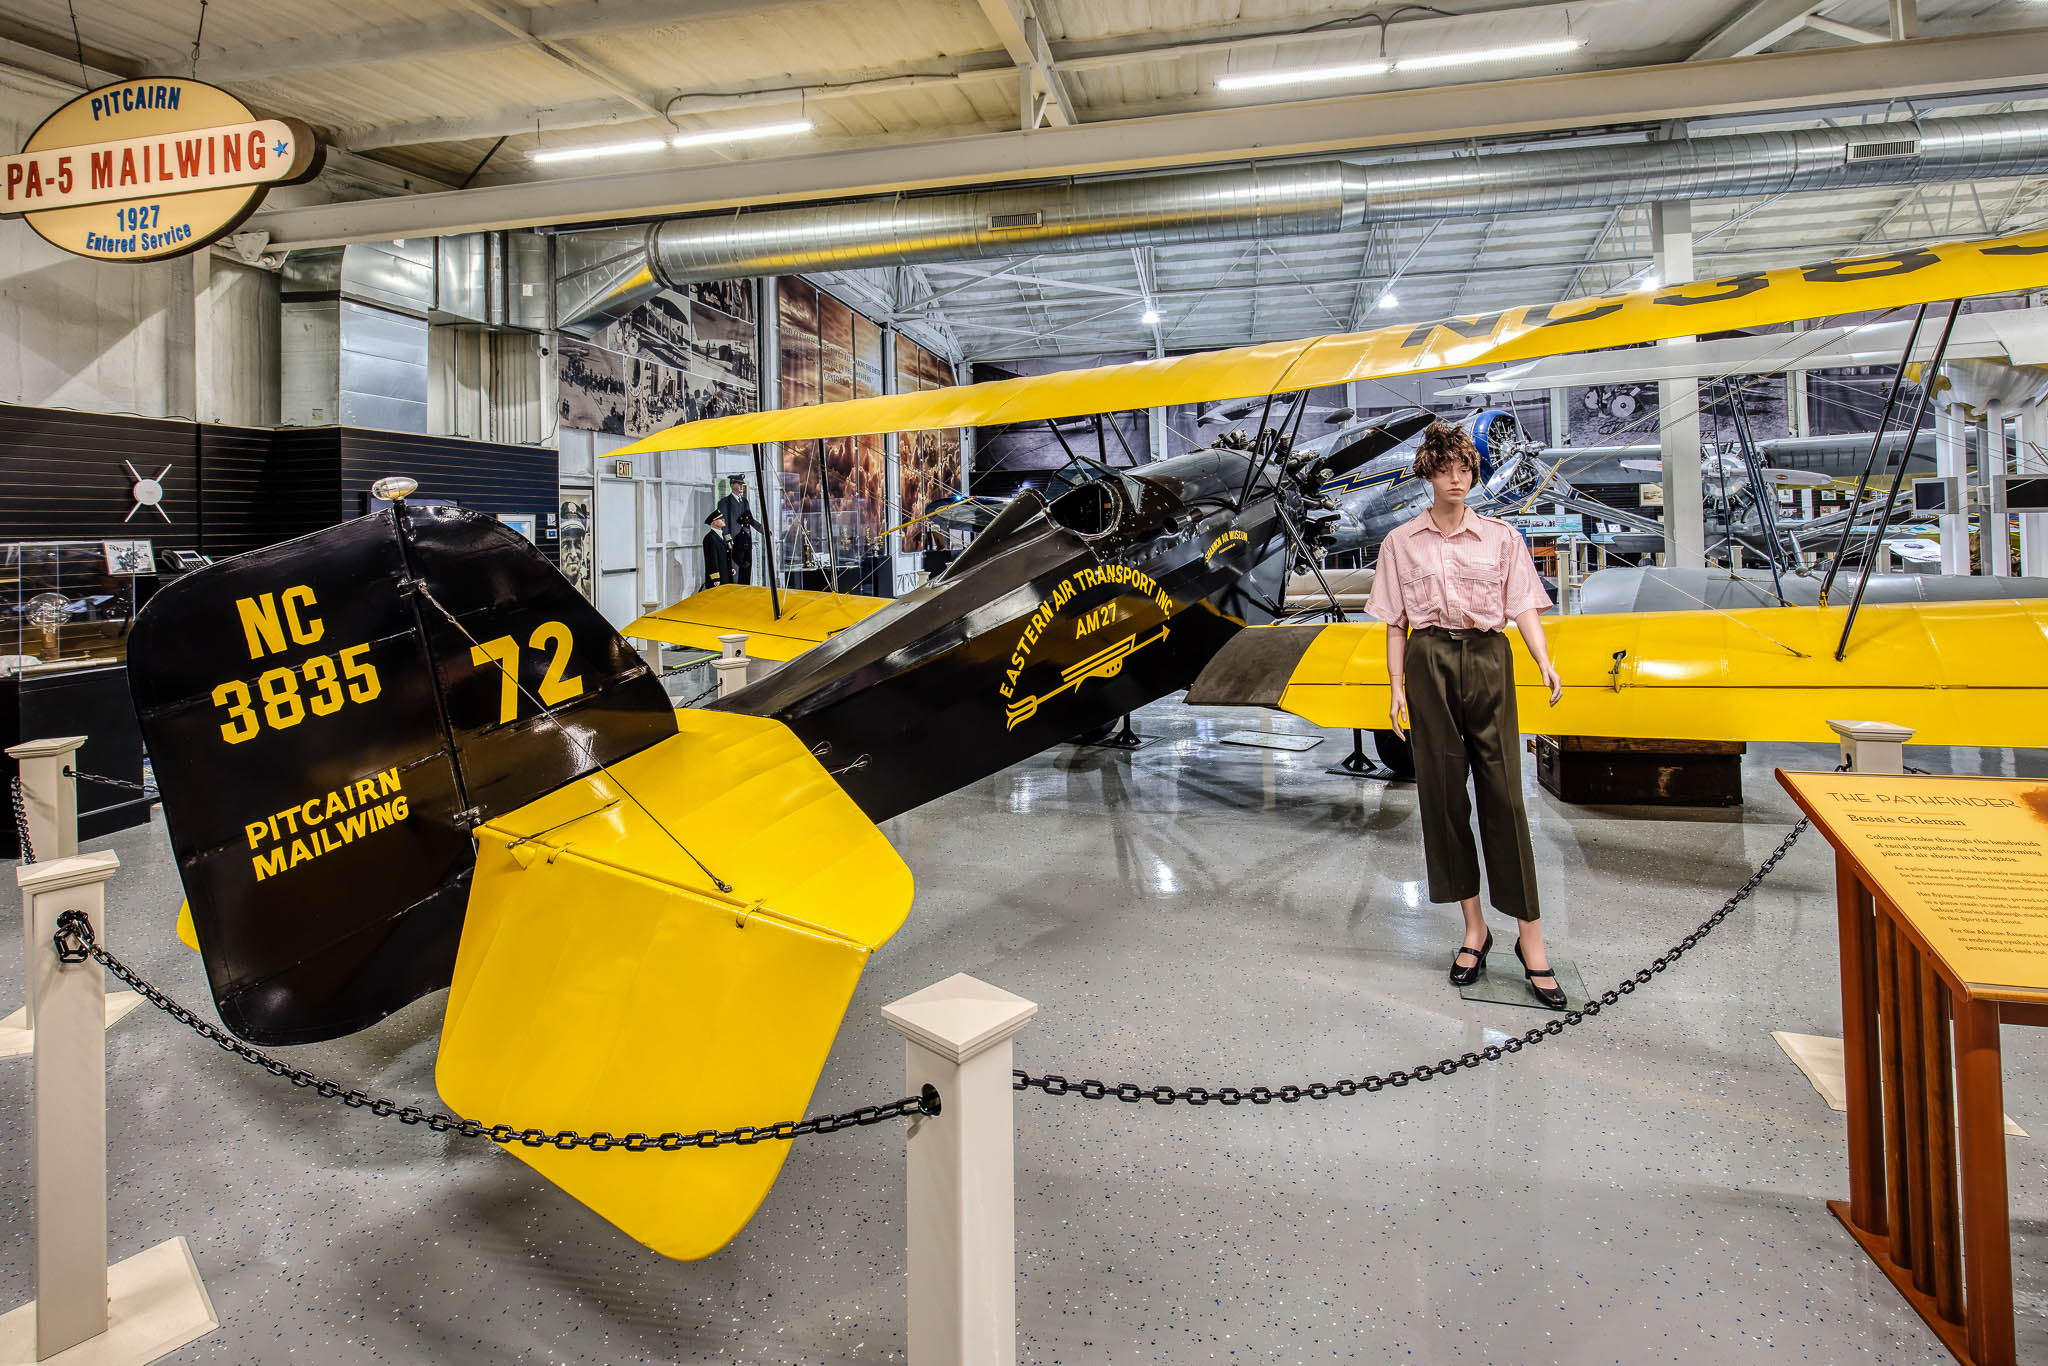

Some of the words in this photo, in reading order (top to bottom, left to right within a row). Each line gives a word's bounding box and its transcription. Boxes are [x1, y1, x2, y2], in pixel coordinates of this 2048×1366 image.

[91, 86, 181, 121] PITCAIRN
[7, 156, 73, 200] PA-5
[91, 129, 267, 190] MAILWING
[86, 231, 136, 253] Entered
[140, 223, 192, 251] Service
[116, 204, 161, 232] 1927
[618, 462, 630, 477] EXIT
[1221, 531, 1230, 544] AIR
[235, 584, 325, 660] NC
[999, 600, 1055, 699] EASTERN
[1052, 579, 1078, 612] AIR
[1073, 564, 1157, 597] TRANSPORT
[1155, 587, 1173, 621] INC.
[211, 642, 382, 745] 3835
[470, 621, 584, 725] 72
[245, 767, 402, 850] PITCAIRN
[1826, 791, 1873, 804] THE
[1875, 793, 2022, 809] PATHFINDER
[1846, 813, 1896, 824] Bessie
[1897, 815, 1968, 827] Coleman
[252, 795, 409, 882] MAILWING
